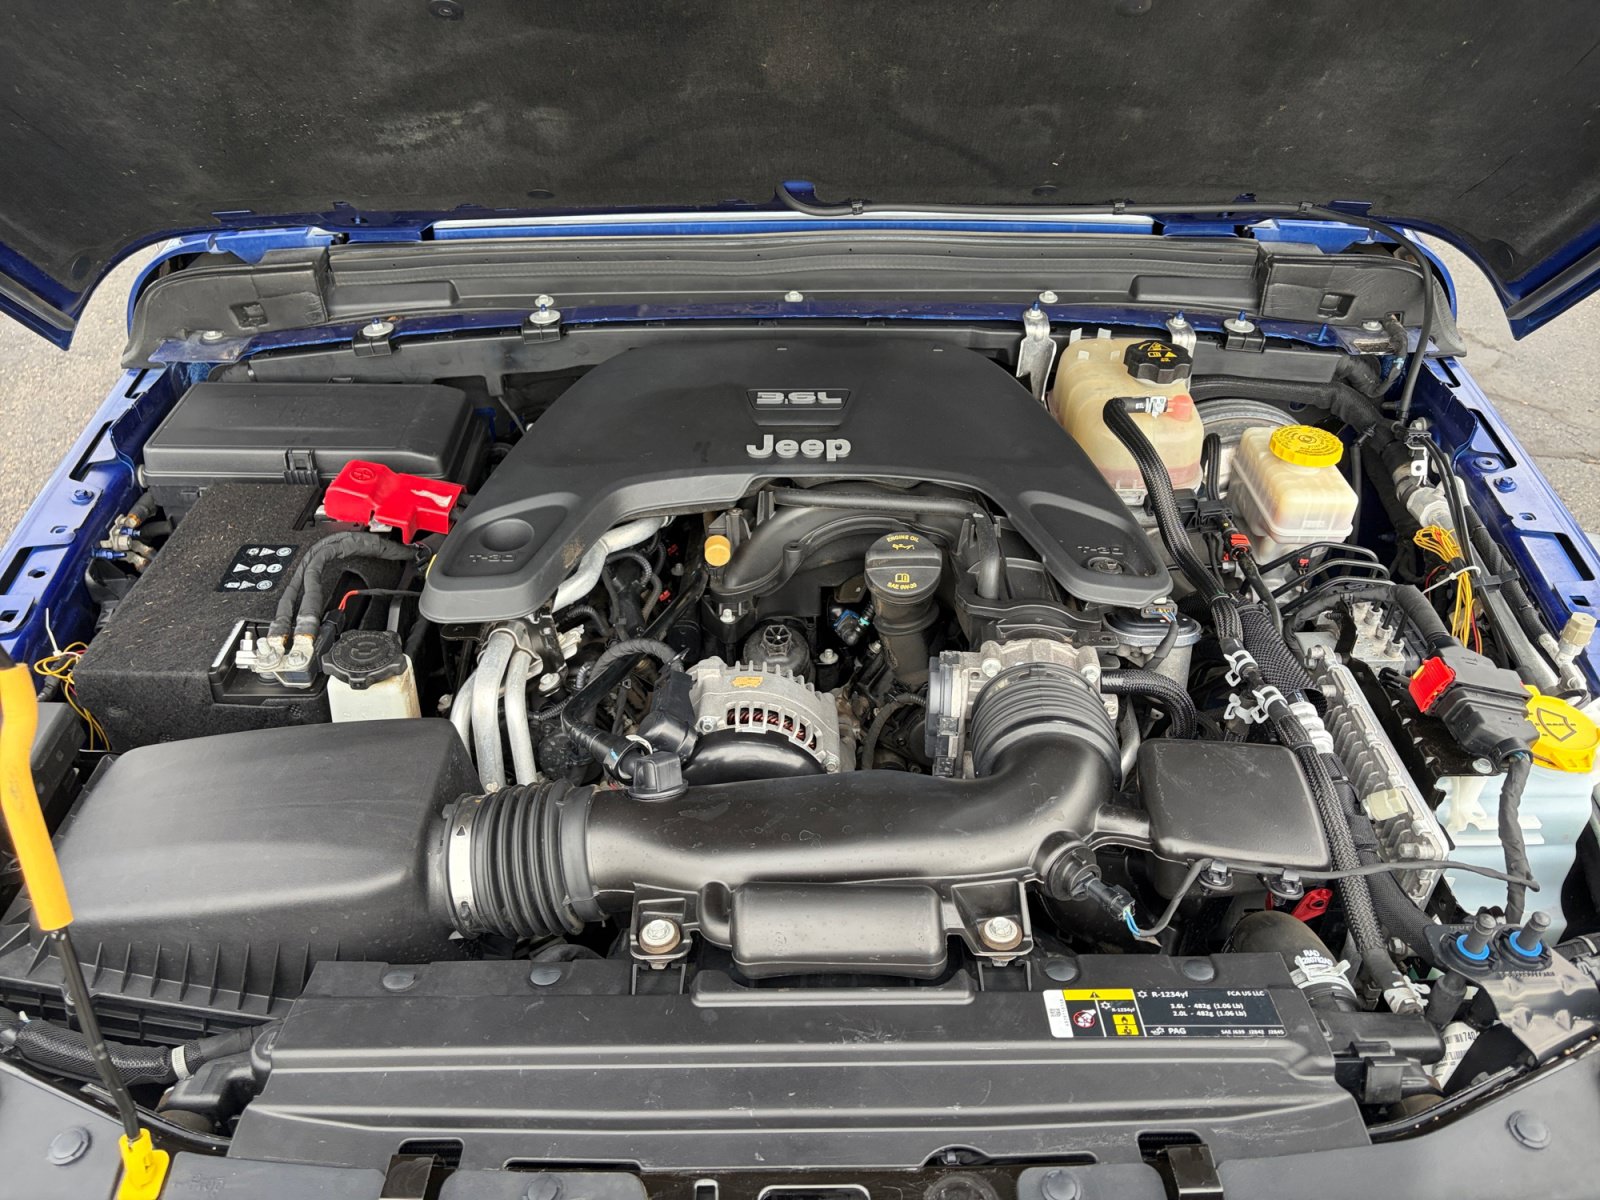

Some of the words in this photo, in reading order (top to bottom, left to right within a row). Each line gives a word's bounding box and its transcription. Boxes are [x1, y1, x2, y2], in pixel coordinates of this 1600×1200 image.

[756, 391, 842, 405] 3.6L
[746, 434, 852, 462] Jeep
[886, 534, 909, 543] ENGINE
[910, 535, 919, 543] OIL
[887, 582, 900, 590] SAE
[1302, 949, 1320, 957] RAD
[1151, 990, 1189, 999] R-1234yf
[1232, 1002, 1244, 1010] Lb)
[1234, 1010, 1247, 1018] Lb)
[1168, 1027, 1187, 1035] PAG
